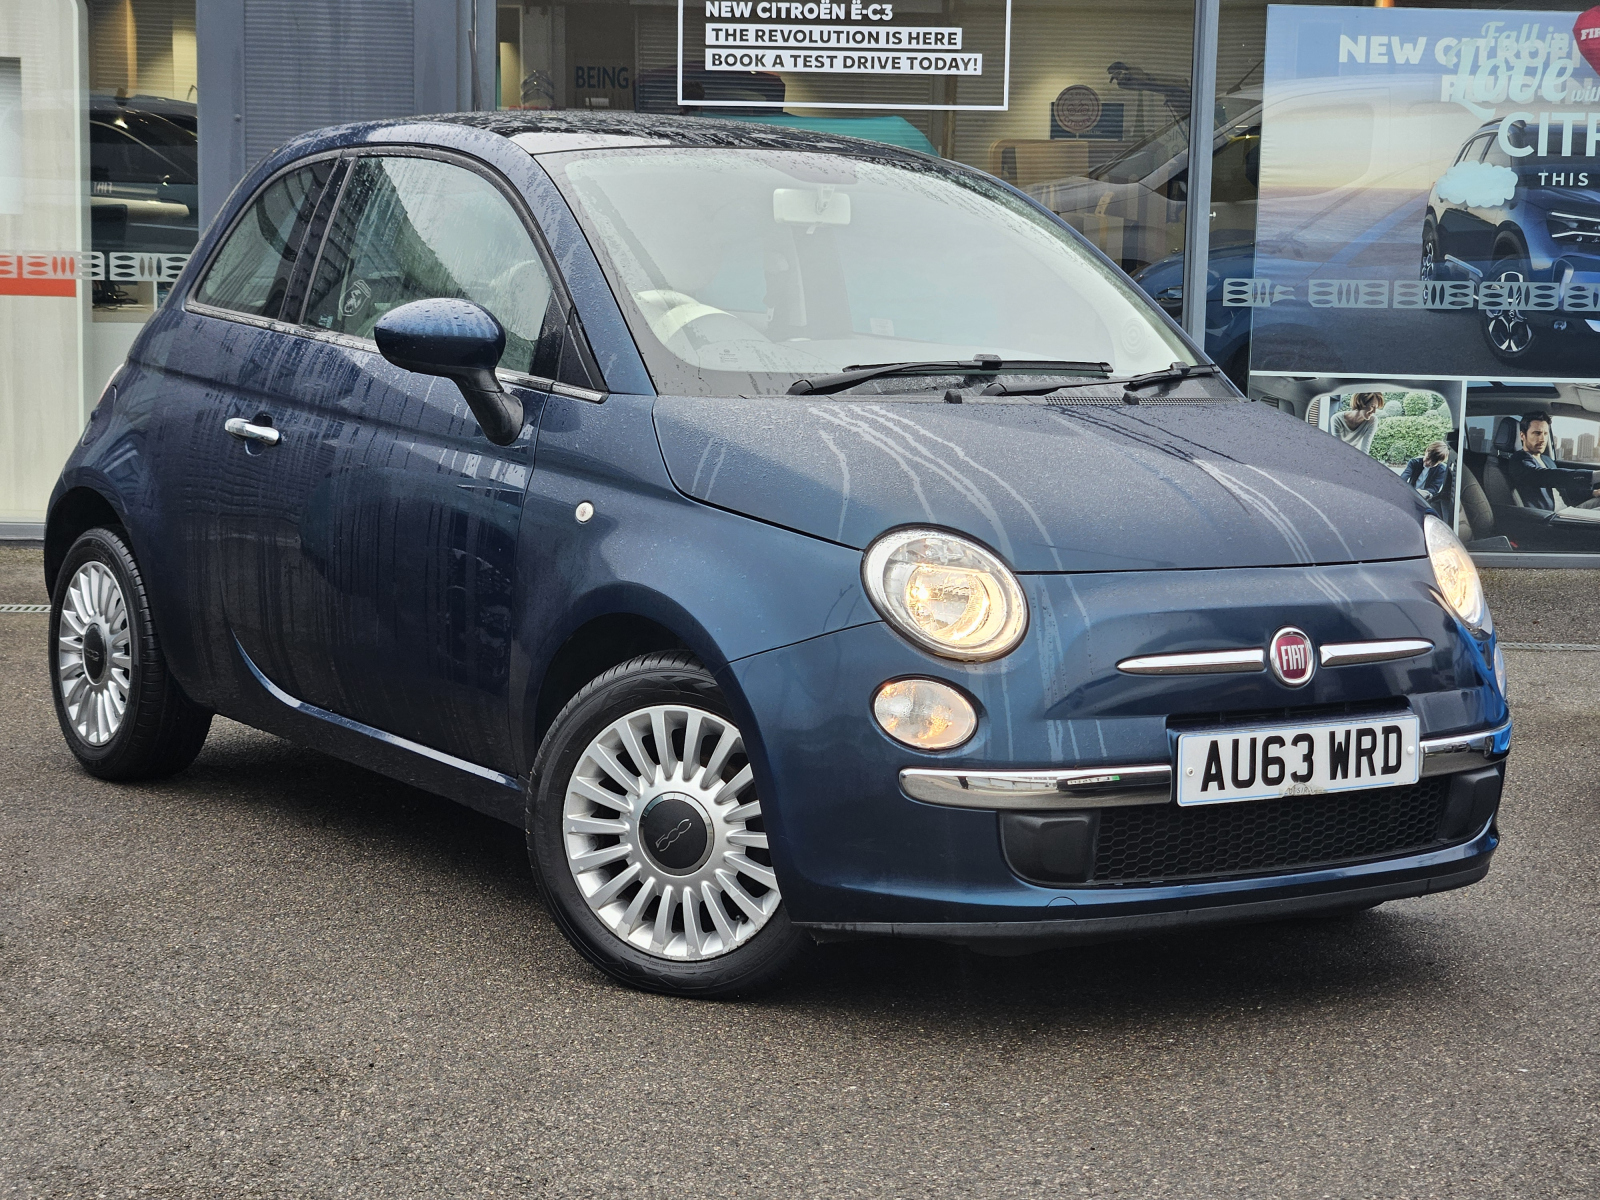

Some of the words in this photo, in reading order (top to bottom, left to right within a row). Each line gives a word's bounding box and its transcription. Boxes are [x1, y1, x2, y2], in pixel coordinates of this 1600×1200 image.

[705, 1, 752, 18] NEW
[756, 0, 846, 20] CITROËN
[850, 0, 893, 21] Ë-C3
[711, 27, 749, 42] THE
[755, 29, 880, 45] REVOLUTION
[885, 31, 903, 45] IS
[907, 31, 958, 46] HERE
[1338, 35, 1427, 65] NEW
[711, 53, 767, 67] BOOK
[771, 54, 785, 68] A
[789, 54, 838, 69] TEST
[842, 55, 902, 70] DRIVE
[906, 56, 978, 72] TODAY!
[575, 66, 630, 90] BEING
[1538, 171, 1589, 187] THIS
[1280, 644, 1306, 671] FIAT
[1200, 732, 1315, 793] AU63
[1328, 724, 1403, 781] WRD
